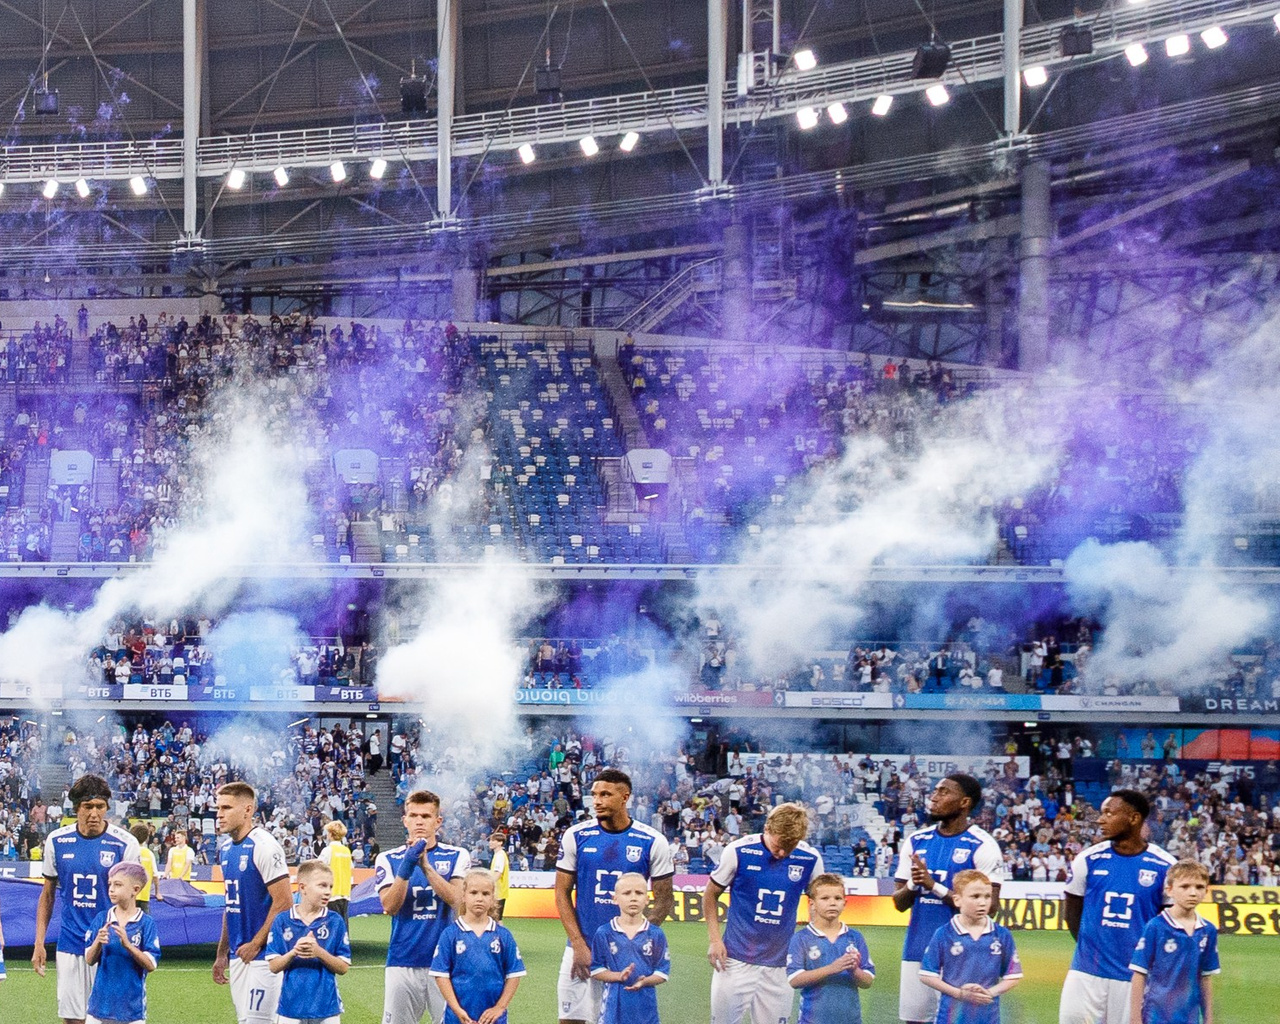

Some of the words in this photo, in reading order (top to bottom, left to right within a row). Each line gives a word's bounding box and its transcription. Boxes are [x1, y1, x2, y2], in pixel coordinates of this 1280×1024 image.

[87, 687, 110, 697] ВТБ
[150, 688, 172, 698] ВТБ
[213, 689, 236, 699] ВТБ
[340, 690, 364, 700] ВТБ
[674, 693, 737, 703] wildberries
[811, 696, 865, 706] BOSCO
[73, 900, 96, 909] Ростех
[412, 912, 436, 920] Ростех
[754, 915, 780, 925] Ростех
[250, 988, 265, 1011] 17
